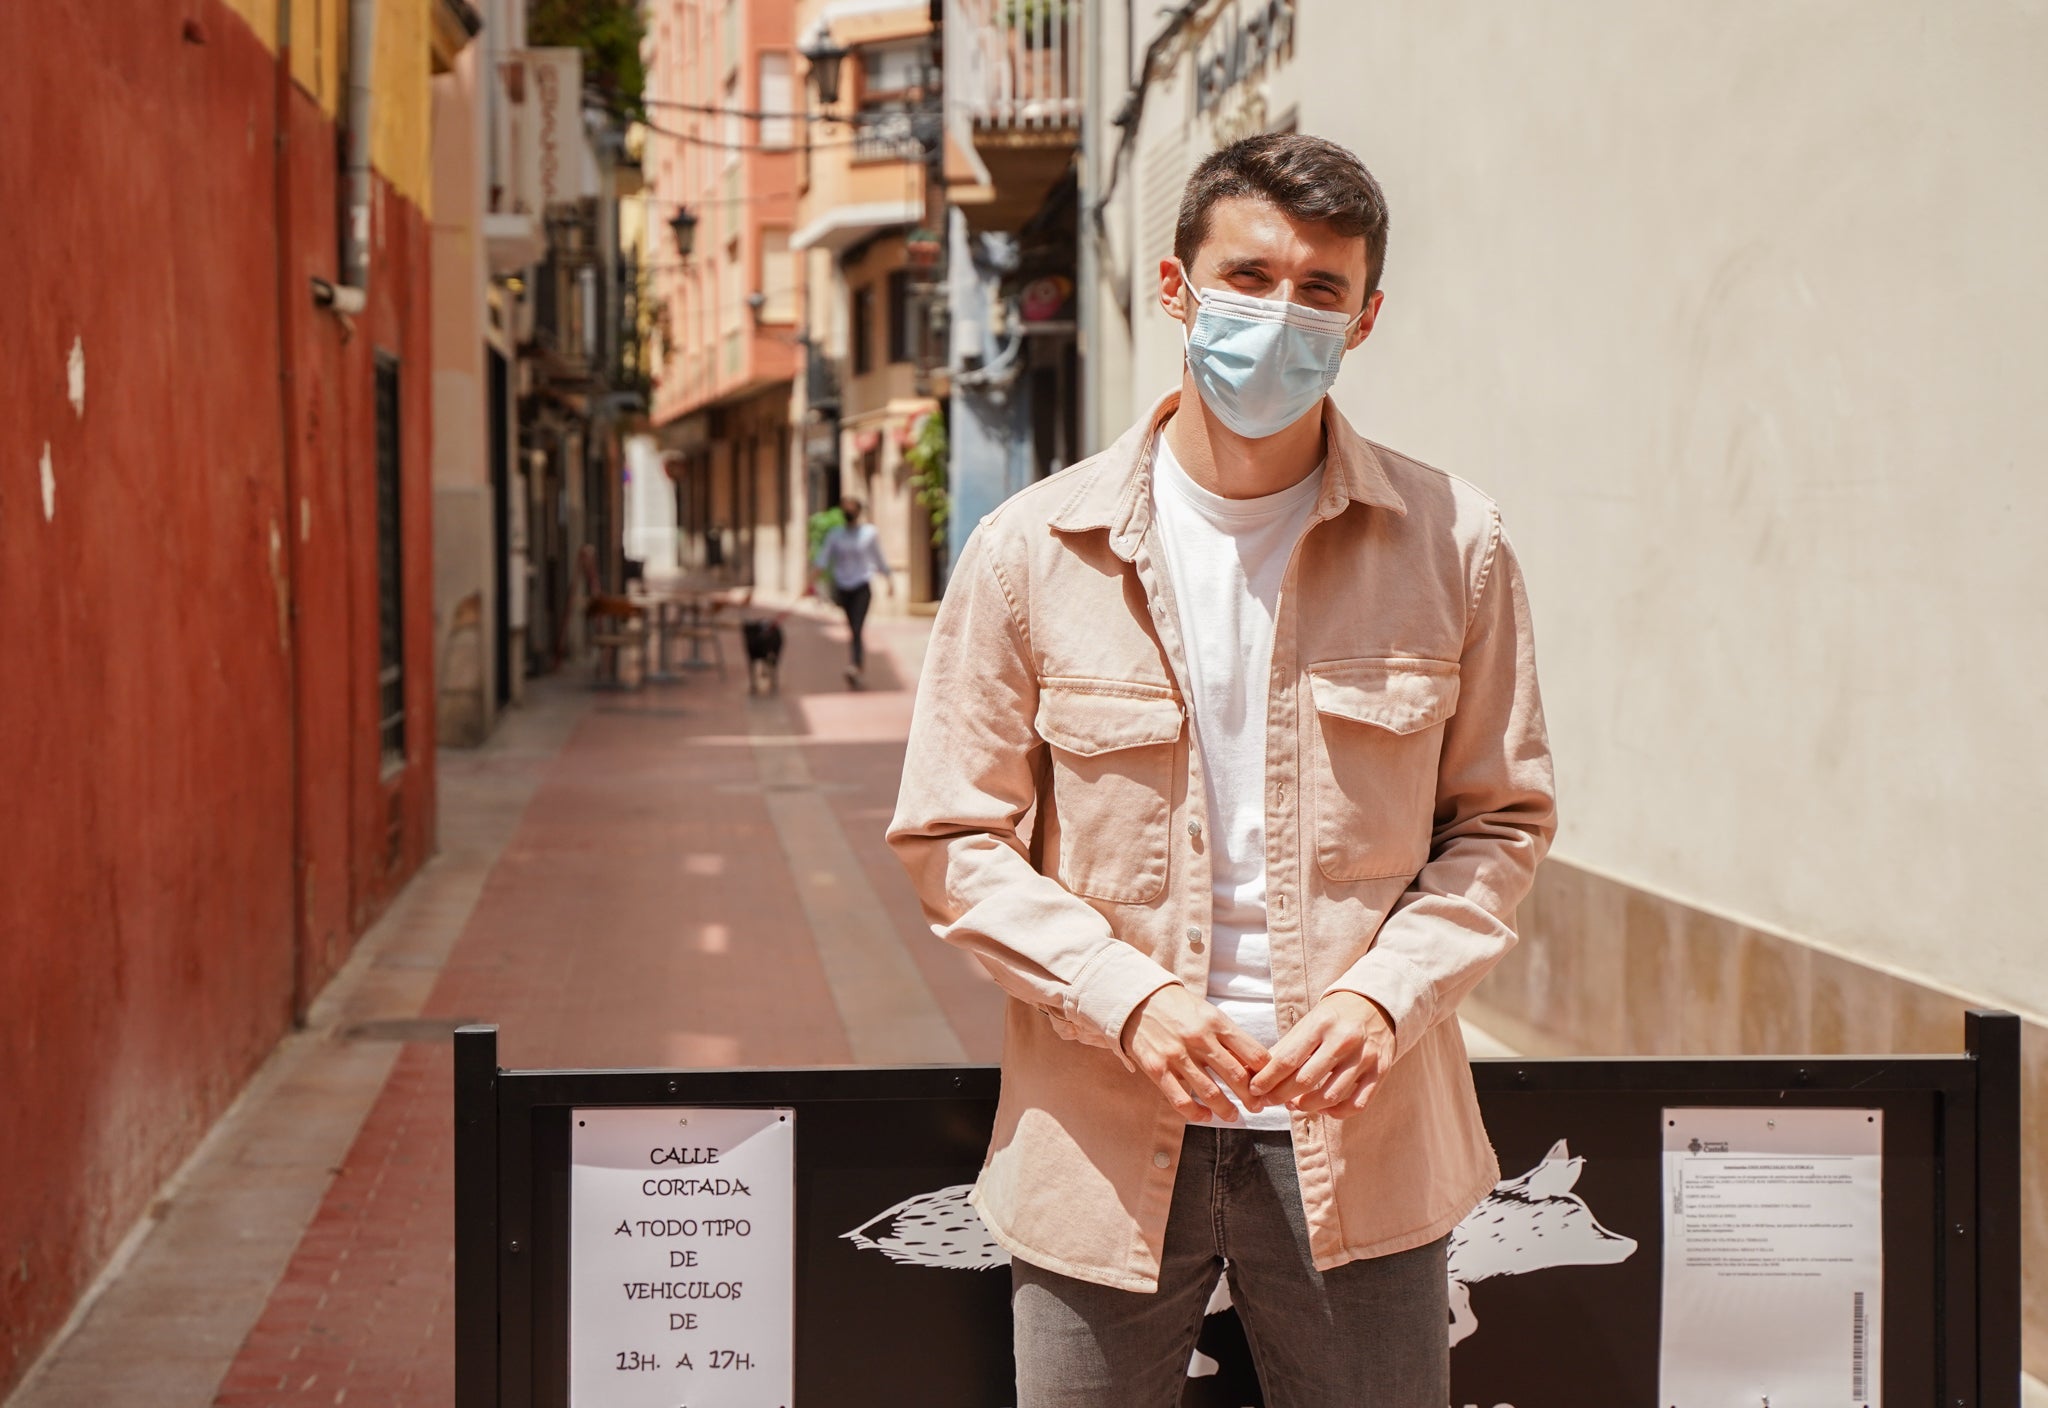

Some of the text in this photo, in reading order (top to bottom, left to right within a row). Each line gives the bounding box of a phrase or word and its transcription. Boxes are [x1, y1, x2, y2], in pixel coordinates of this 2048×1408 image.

[650, 1147, 719, 1165] CALLE
[642, 1178, 751, 1196] CORTADA
[614, 1219, 751, 1237] A TODO TIPO
[670, 1251, 698, 1268] DE
[623, 1282, 742, 1300] VEHICULOS
[670, 1313, 698, 1331] DE
[616, 1350, 755, 1371] 13H. A 17H.
